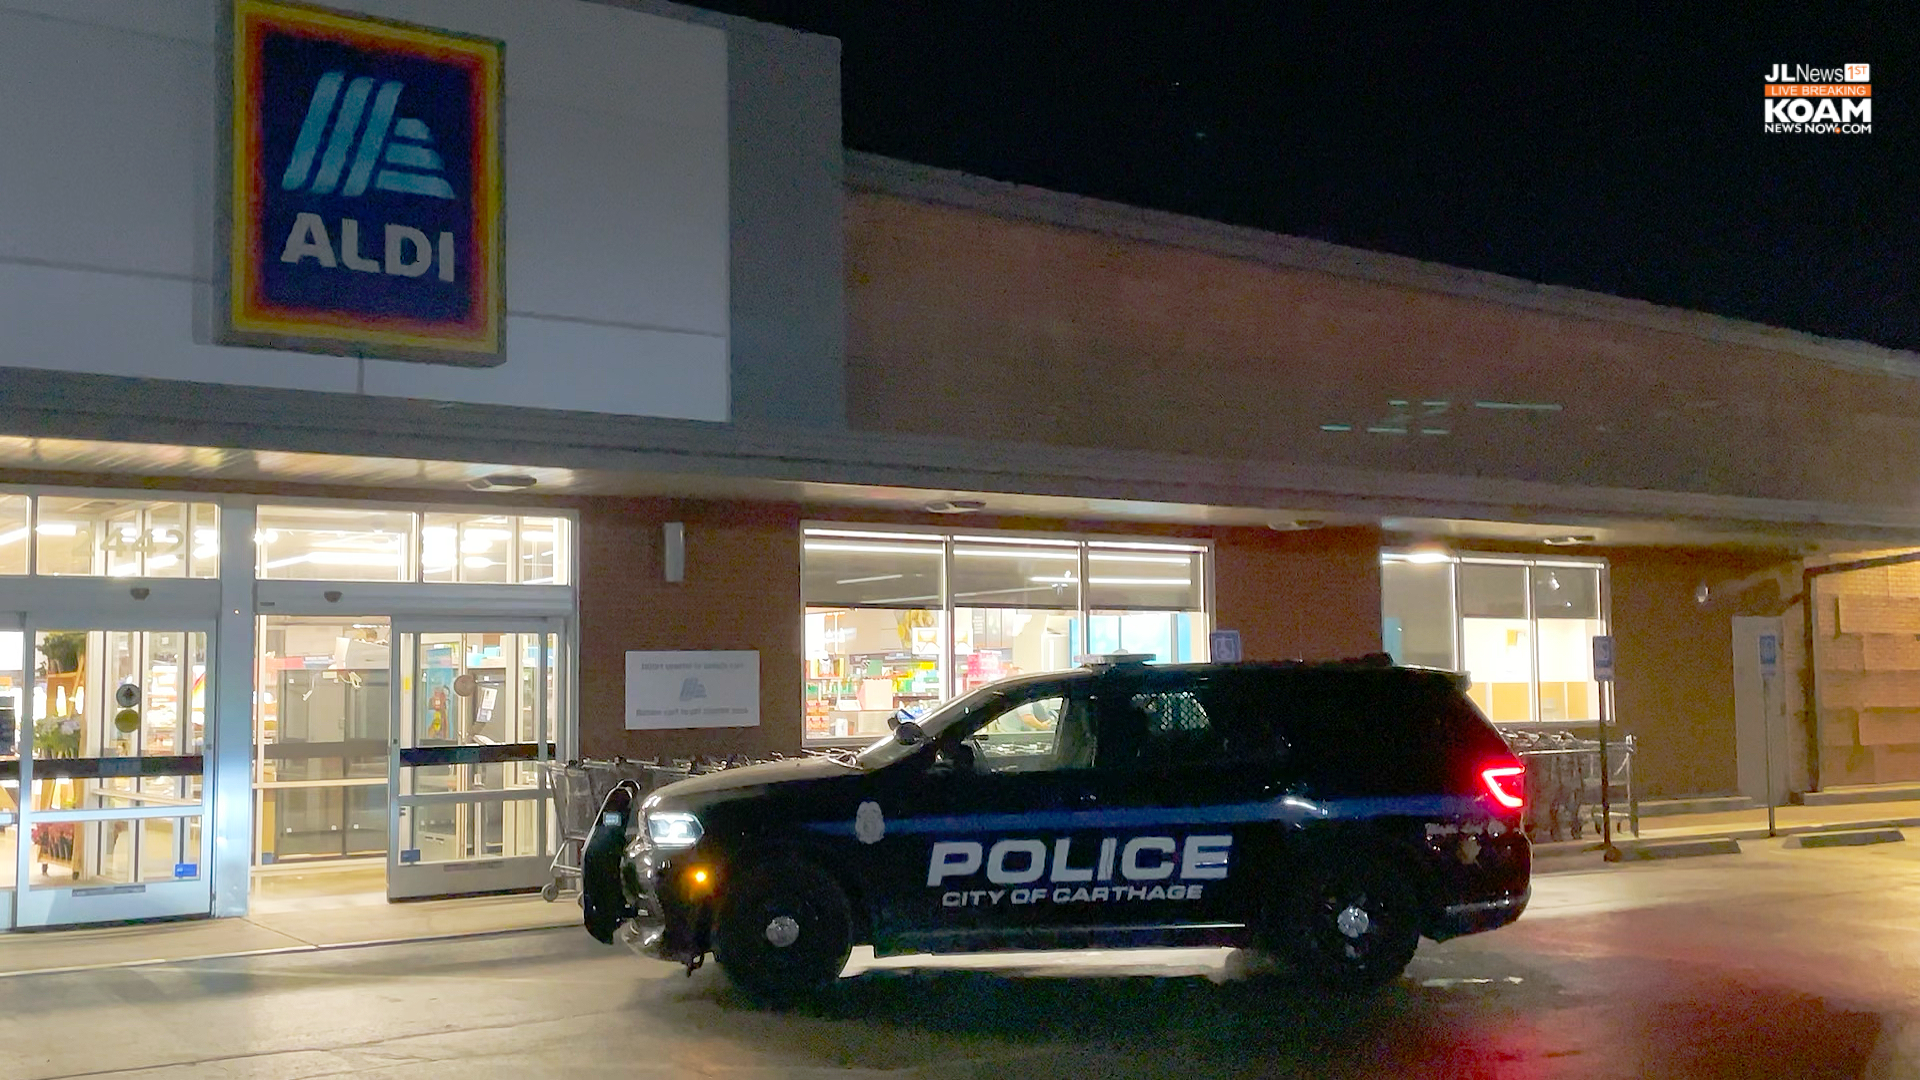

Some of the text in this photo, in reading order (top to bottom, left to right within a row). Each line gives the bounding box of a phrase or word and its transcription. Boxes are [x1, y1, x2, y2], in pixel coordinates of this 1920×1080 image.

[280, 212, 455, 282] ALDI
[926, 834, 1233, 887] POLICE
[942, 885, 1204, 907] CITY OF CARTHAGE
